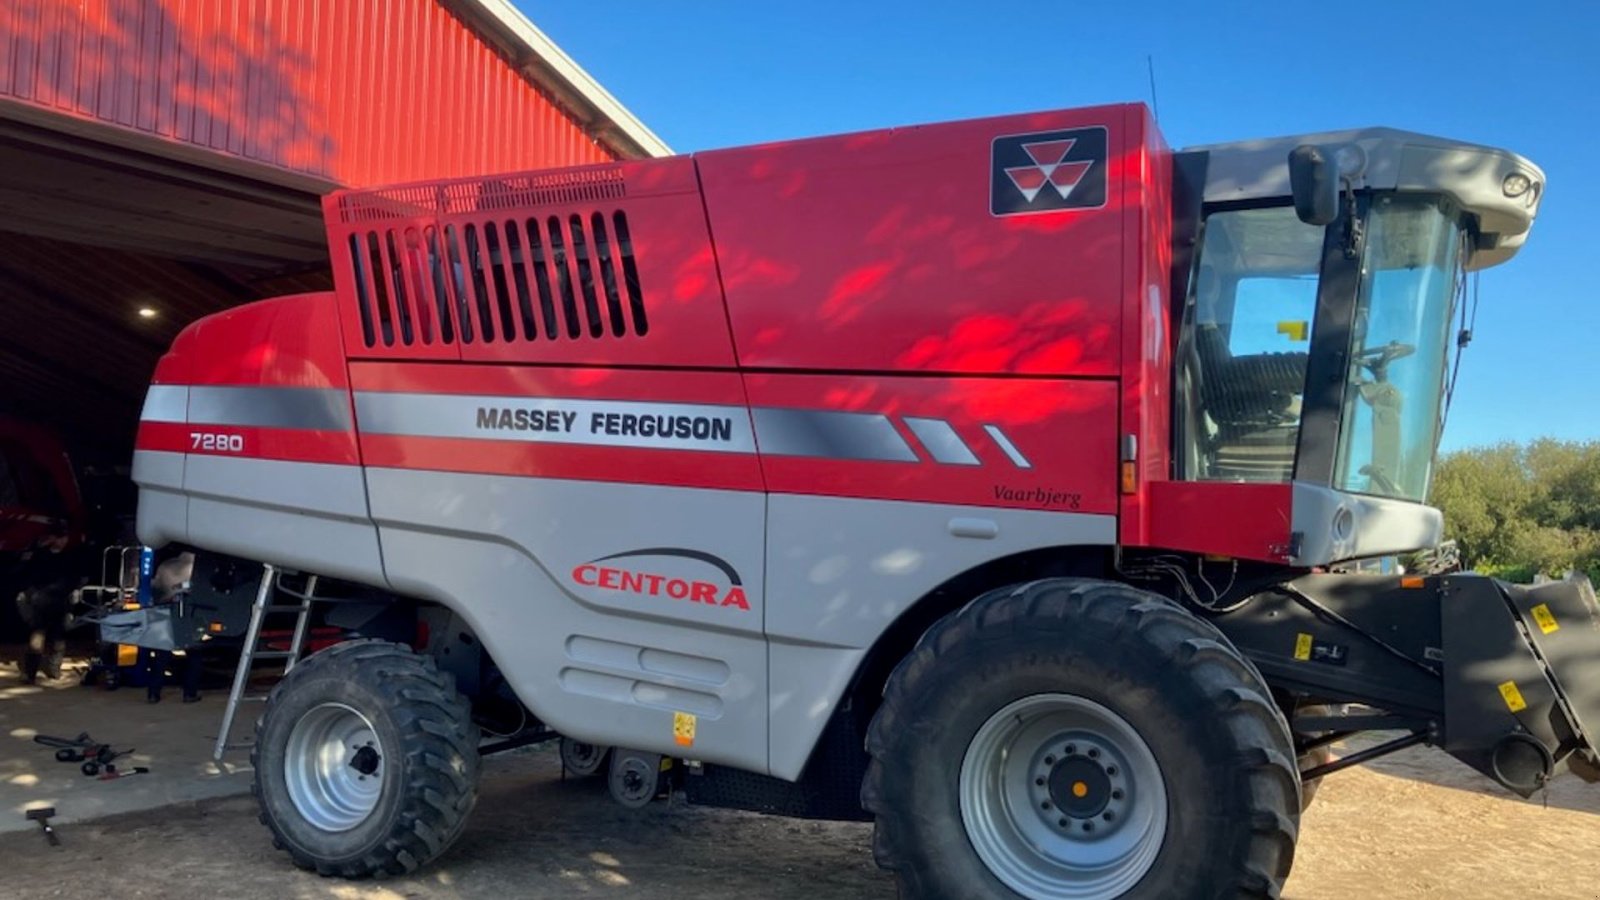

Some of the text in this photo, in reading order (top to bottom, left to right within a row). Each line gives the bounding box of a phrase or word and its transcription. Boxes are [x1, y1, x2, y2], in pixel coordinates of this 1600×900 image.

[476, 408, 732, 441] MASSEY FERGUSON
[190, 433, 243, 452] 7280
[994, 485, 1081, 509] Vaarbjerg
[572, 565, 751, 611] CENTORA
